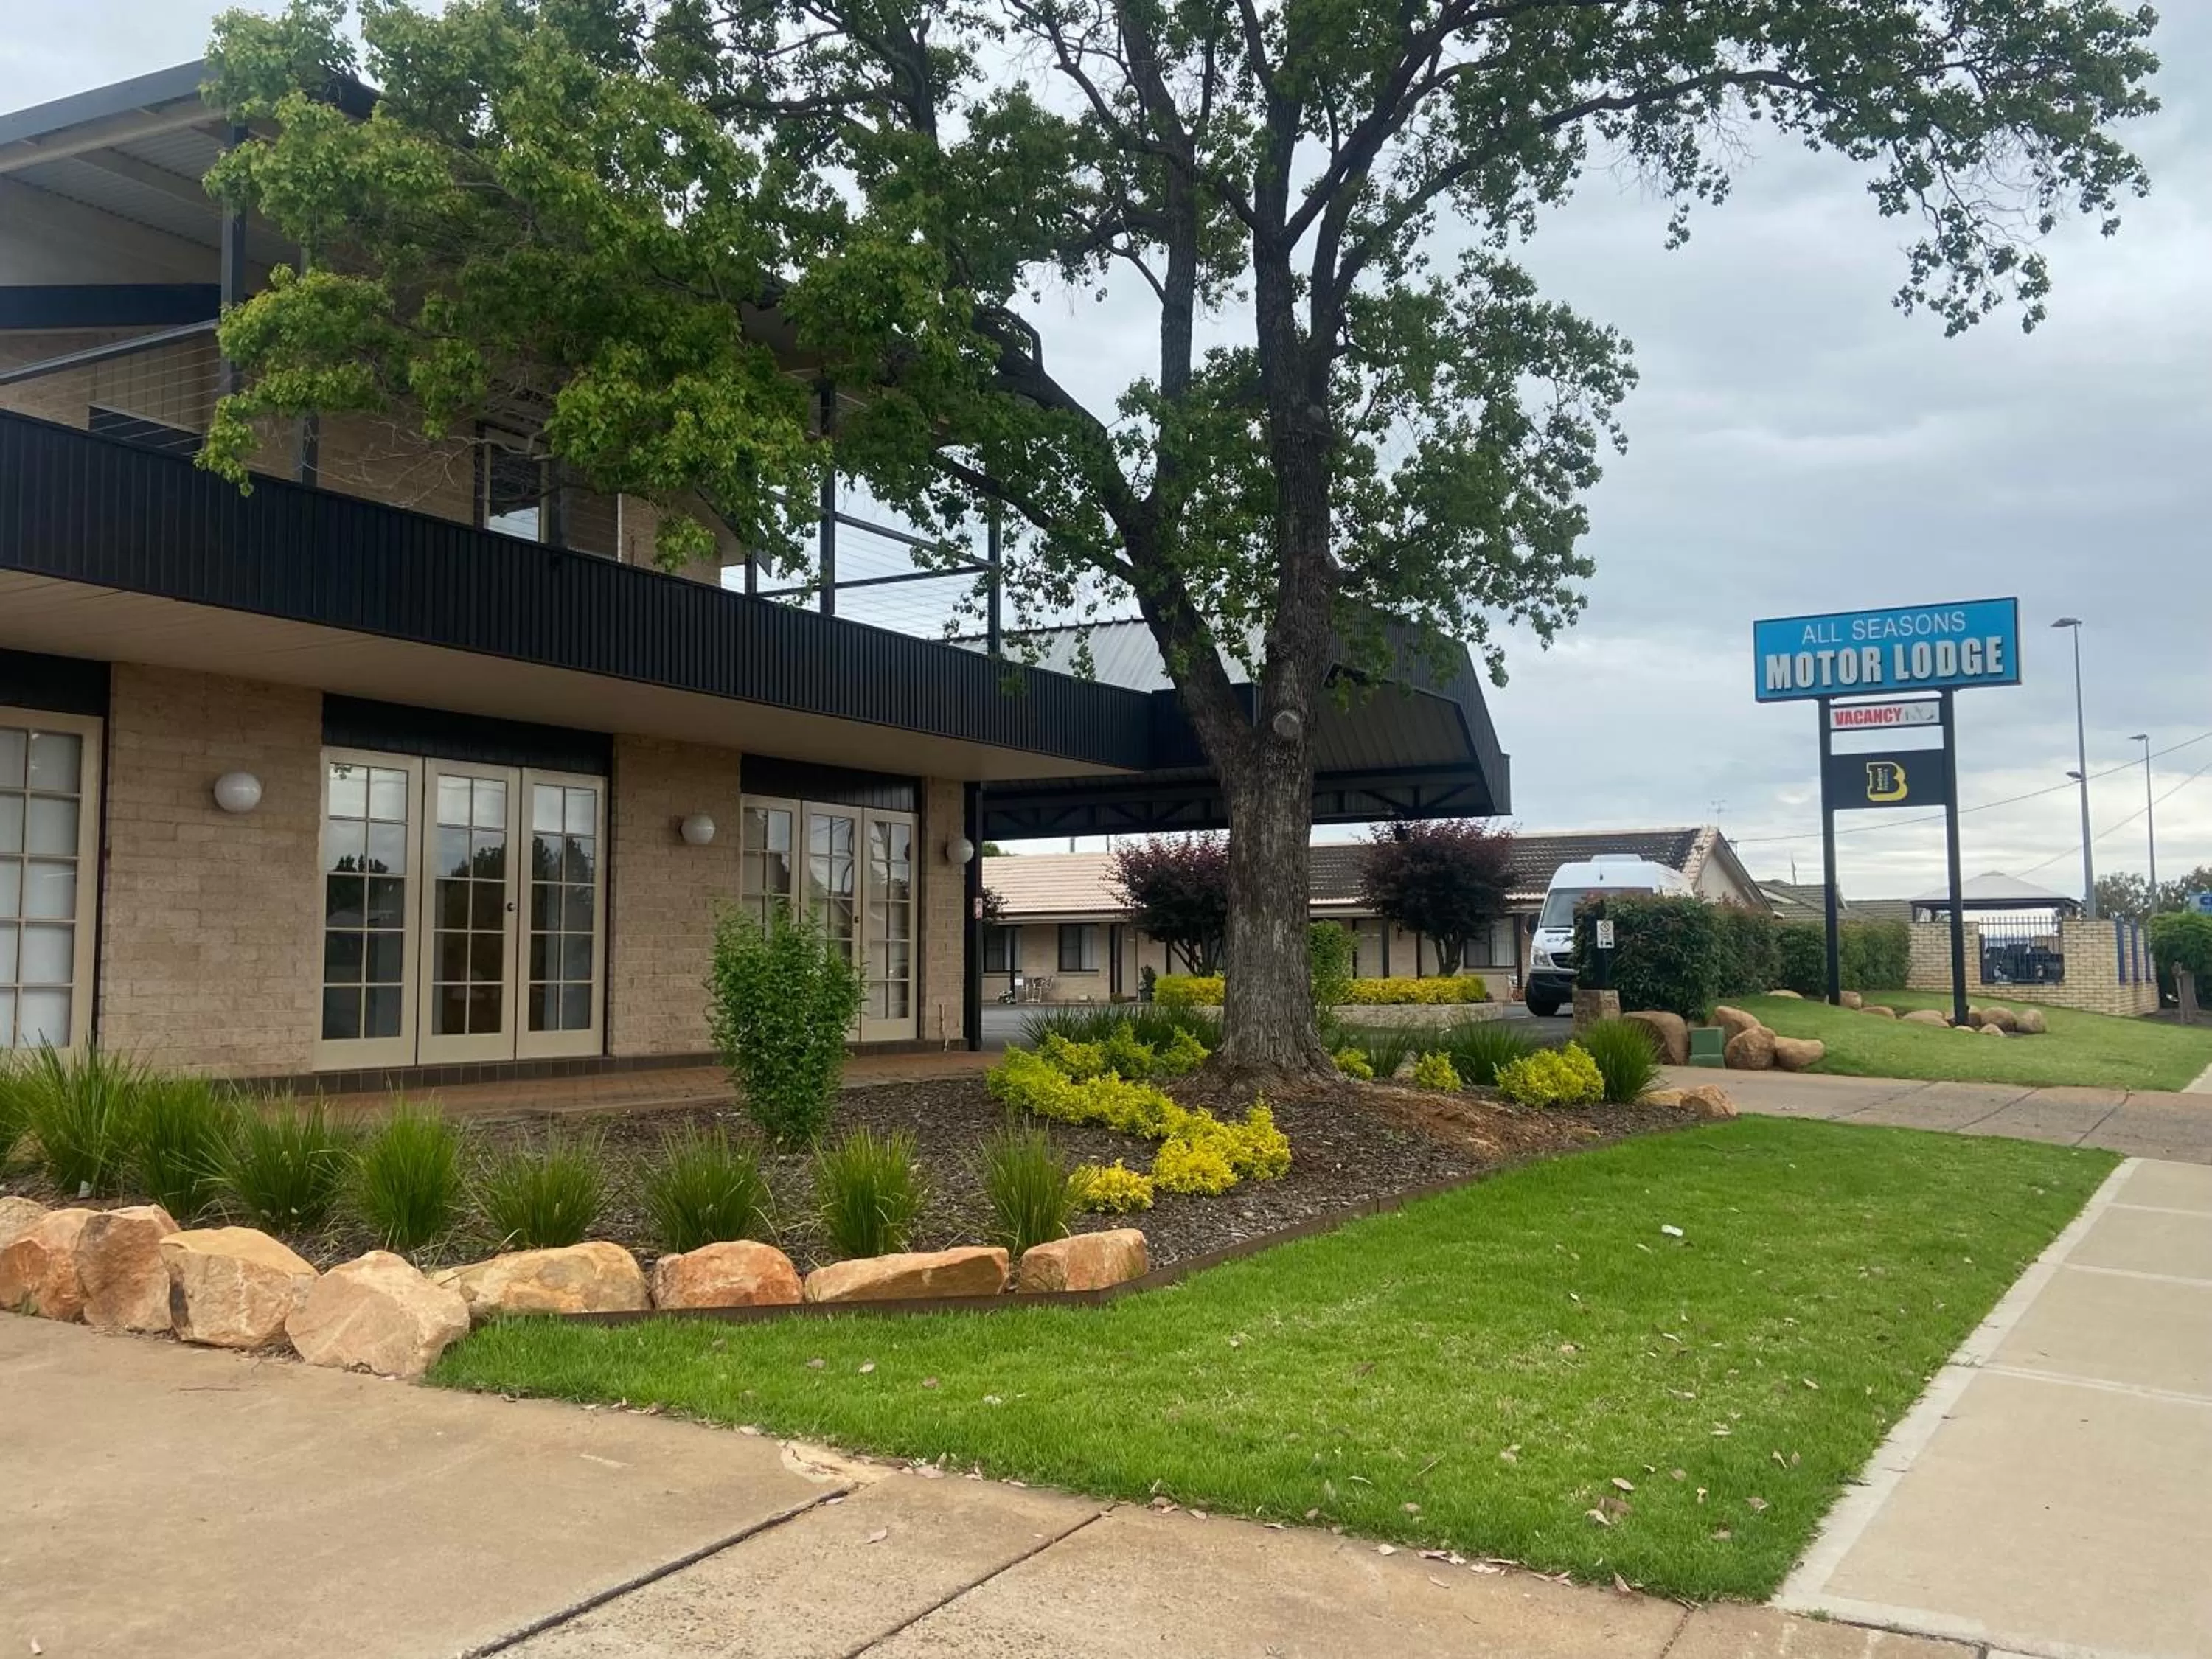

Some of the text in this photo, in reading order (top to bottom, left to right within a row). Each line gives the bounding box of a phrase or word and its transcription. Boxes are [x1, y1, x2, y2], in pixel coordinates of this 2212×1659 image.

[1801, 611, 1966, 645] ALL SEASONS
[1765, 636, 2004, 691] MOTOR LODGE
[1834, 707, 1902, 726] VACANCY
[1866, 762, 1908, 801] B
